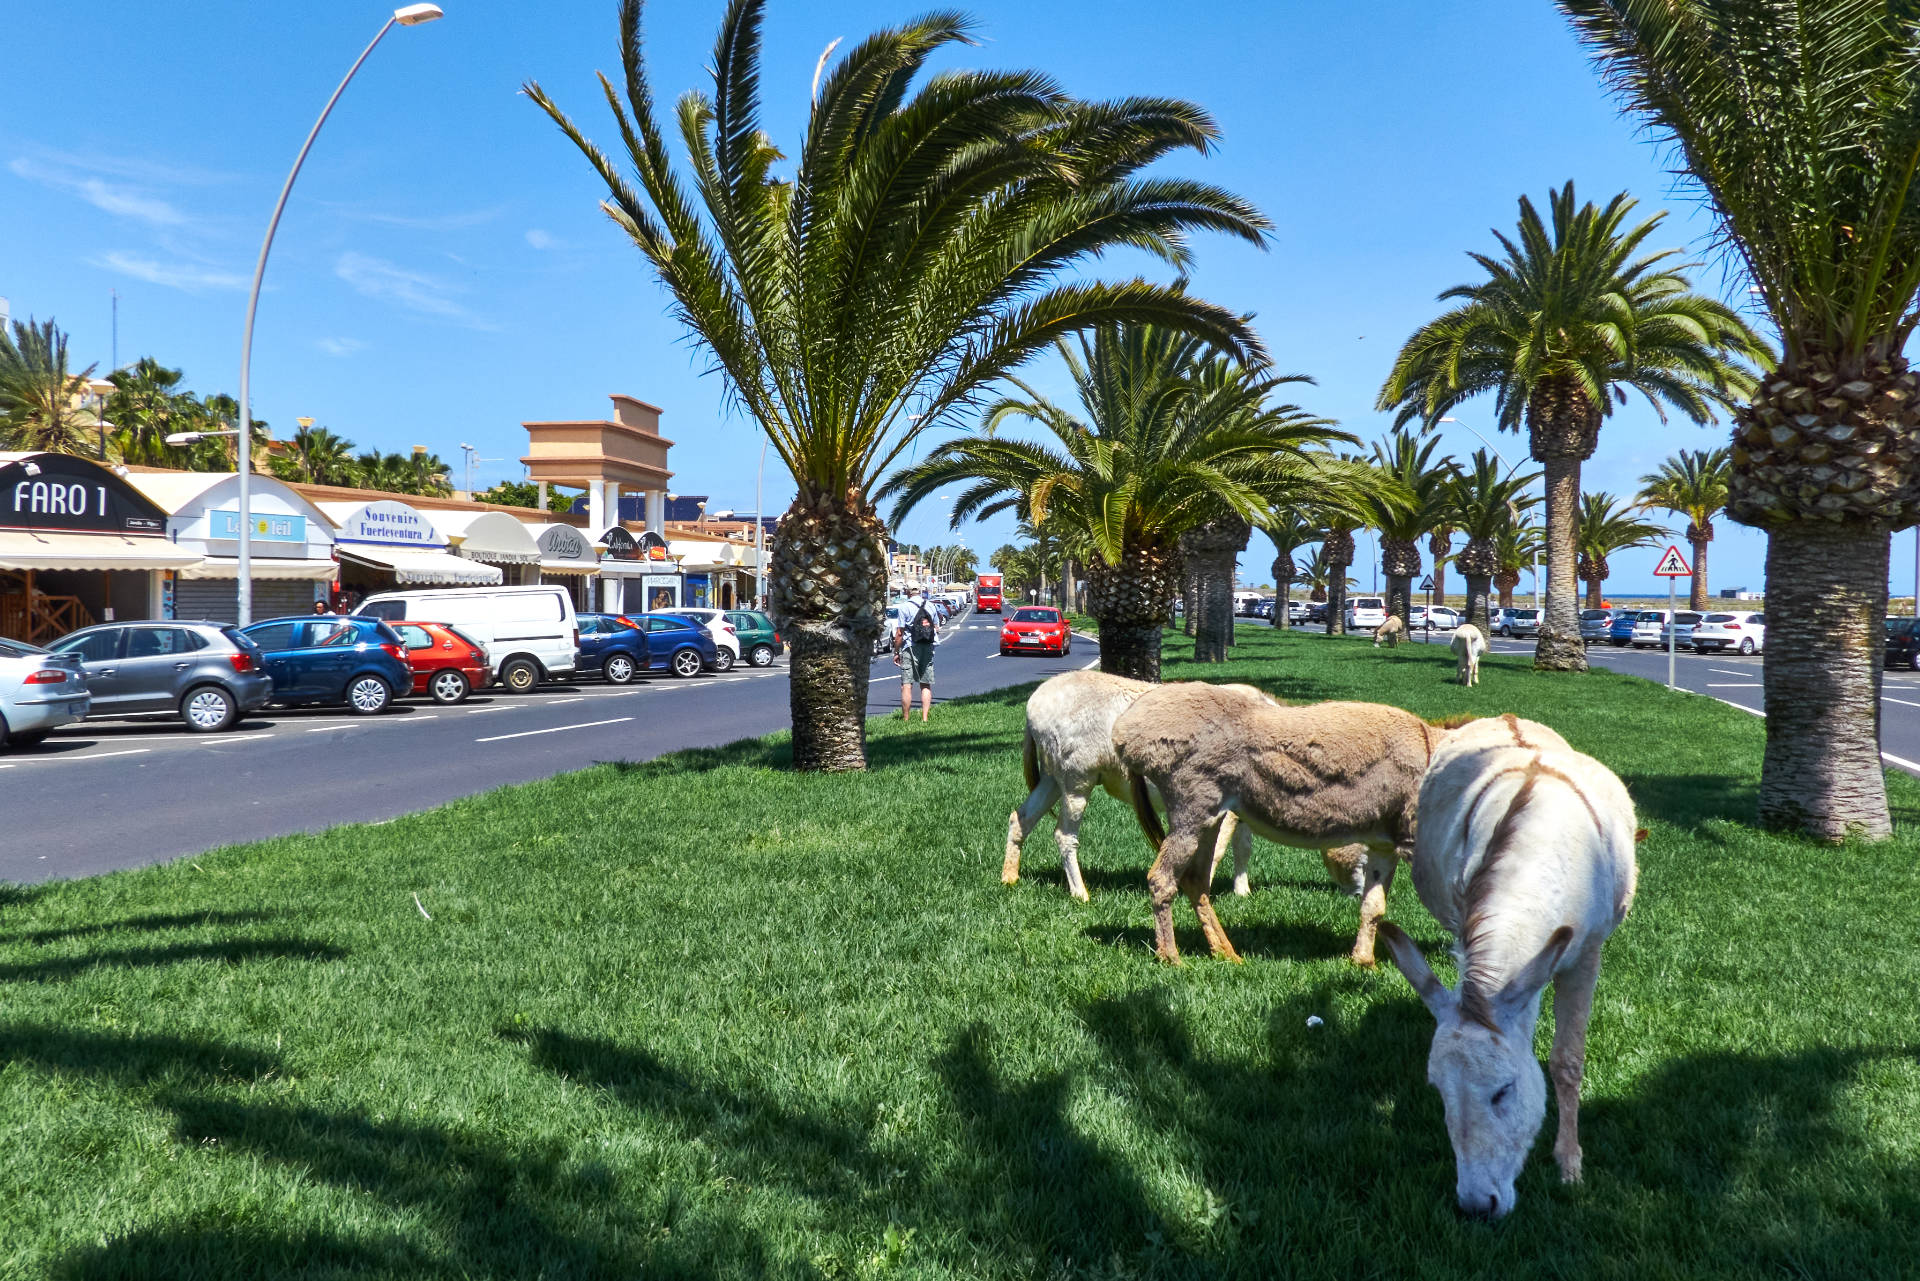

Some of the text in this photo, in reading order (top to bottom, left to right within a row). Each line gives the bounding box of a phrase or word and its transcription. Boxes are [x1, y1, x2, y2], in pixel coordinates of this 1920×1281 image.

[14, 481, 106, 517] FARO 1
[365, 506, 419, 525] Souvenirs
[360, 522, 423, 540] Fuerteventura
[471, 551, 497, 560] BOUTIQUE
